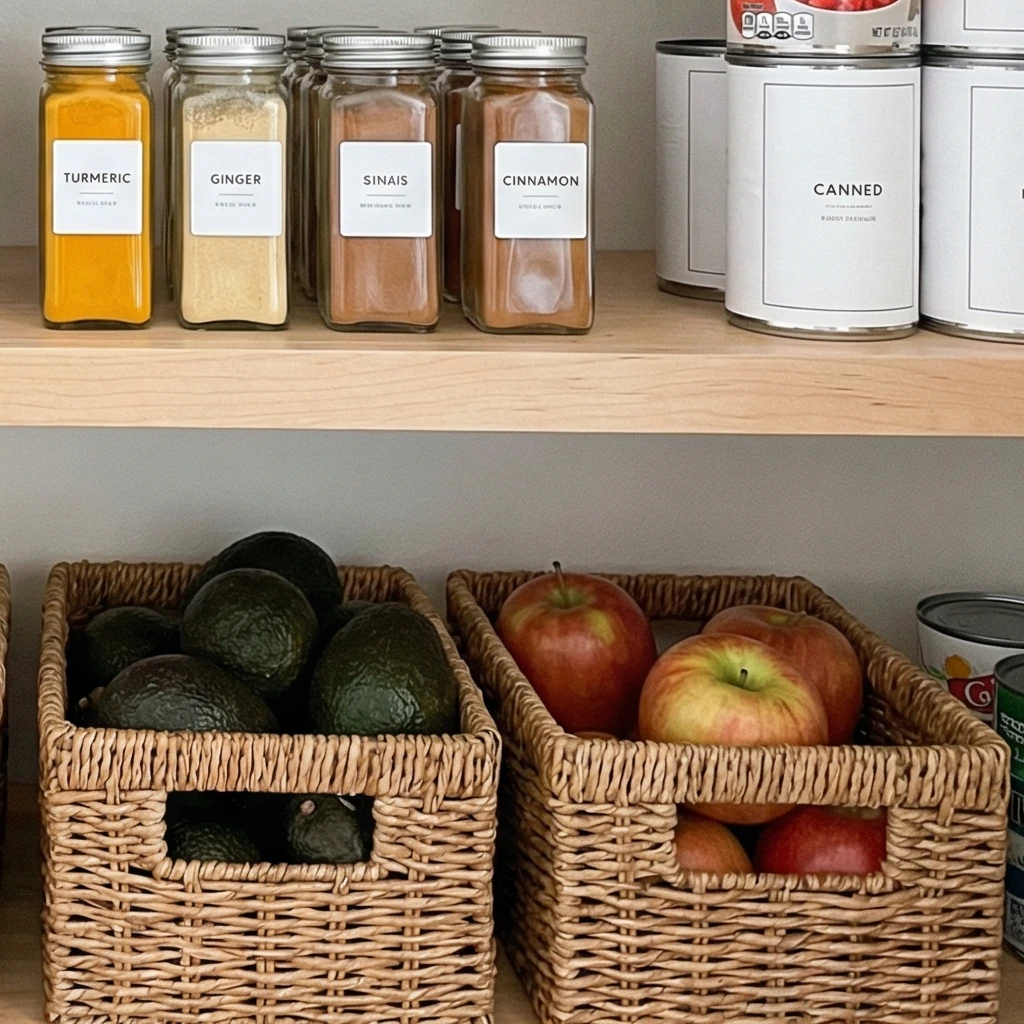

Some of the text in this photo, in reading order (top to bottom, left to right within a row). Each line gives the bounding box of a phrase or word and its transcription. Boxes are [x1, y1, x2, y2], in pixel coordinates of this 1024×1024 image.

[63, 172, 132, 184] TURMERIC
[210, 173, 262, 185] GINGER
[363, 175, 409, 187] SINAIS
[502, 175, 580, 187] CINNAMON
[813, 183, 883, 196] CANNED
